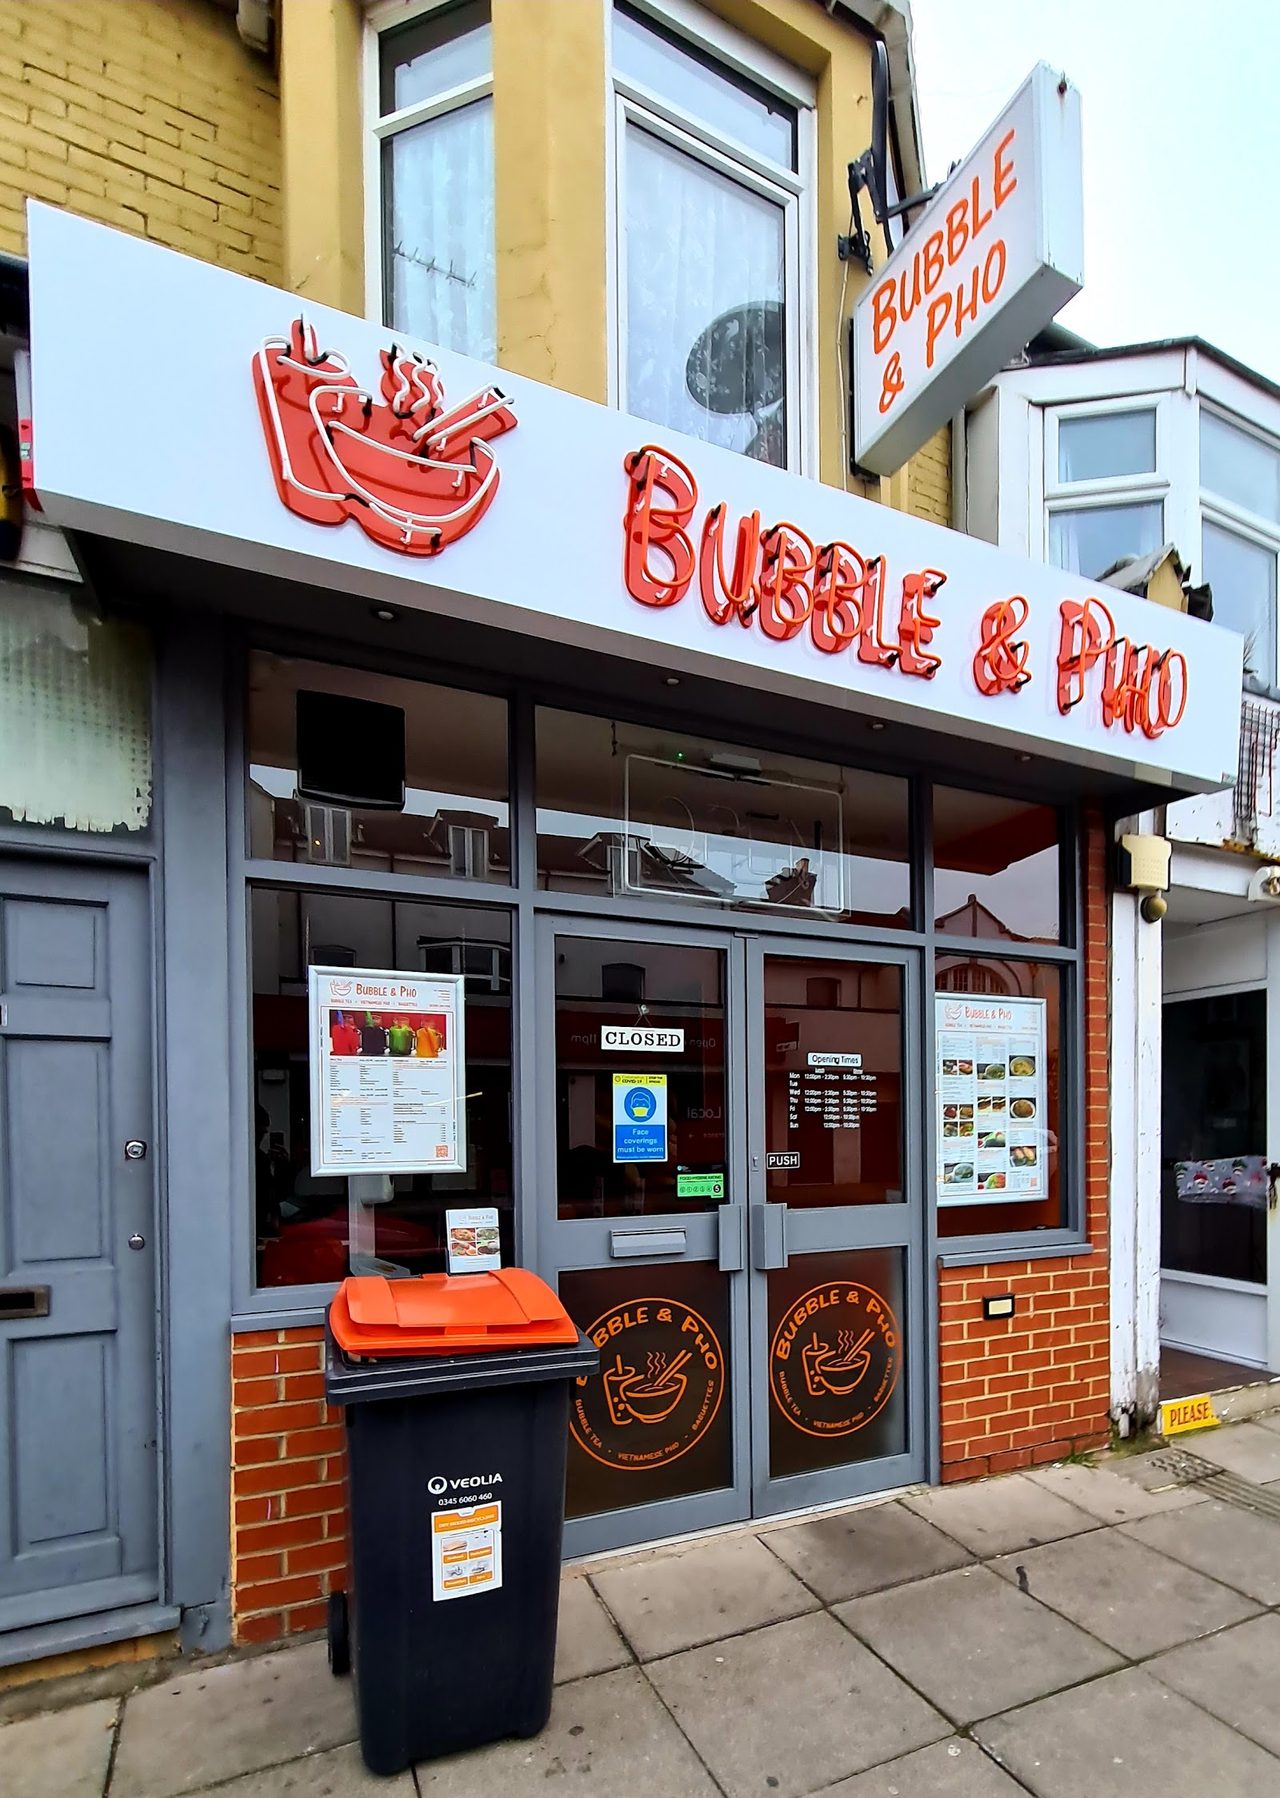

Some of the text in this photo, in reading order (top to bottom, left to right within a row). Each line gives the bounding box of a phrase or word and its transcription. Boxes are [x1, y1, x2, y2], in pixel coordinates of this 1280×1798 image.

[872, 128, 1018, 354] BUBBLE
[878, 239, 1007, 414] & PHO
[623, 444, 1188, 739] BUBBLE & PHO
[356, 983, 388, 997] BUBBLE
[400, 986, 417, 998] PHO
[605, 1031, 681, 1047] CLOSED
[812, 1054, 859, 1065] Opening Times
[632, 1128, 649, 1136] Face
[769, 1156, 798, 1166] PUSH
[656, 1308, 673, 1323] &
[681, 1316, 718, 1370] PHO
[776, 1289, 896, 1360] BUBBLE & PHO
[779, 1370, 793, 1403] BUBBLE
[790, 1402, 802, 1416] TEA
[575, 1379, 715, 1462] BUBBLE TEA VIETNAMESE PHO BAGUETTES
[449, 1473, 503, 1489] VEOLIA
[438, 1492, 493, 1506] 0345 6060 460
